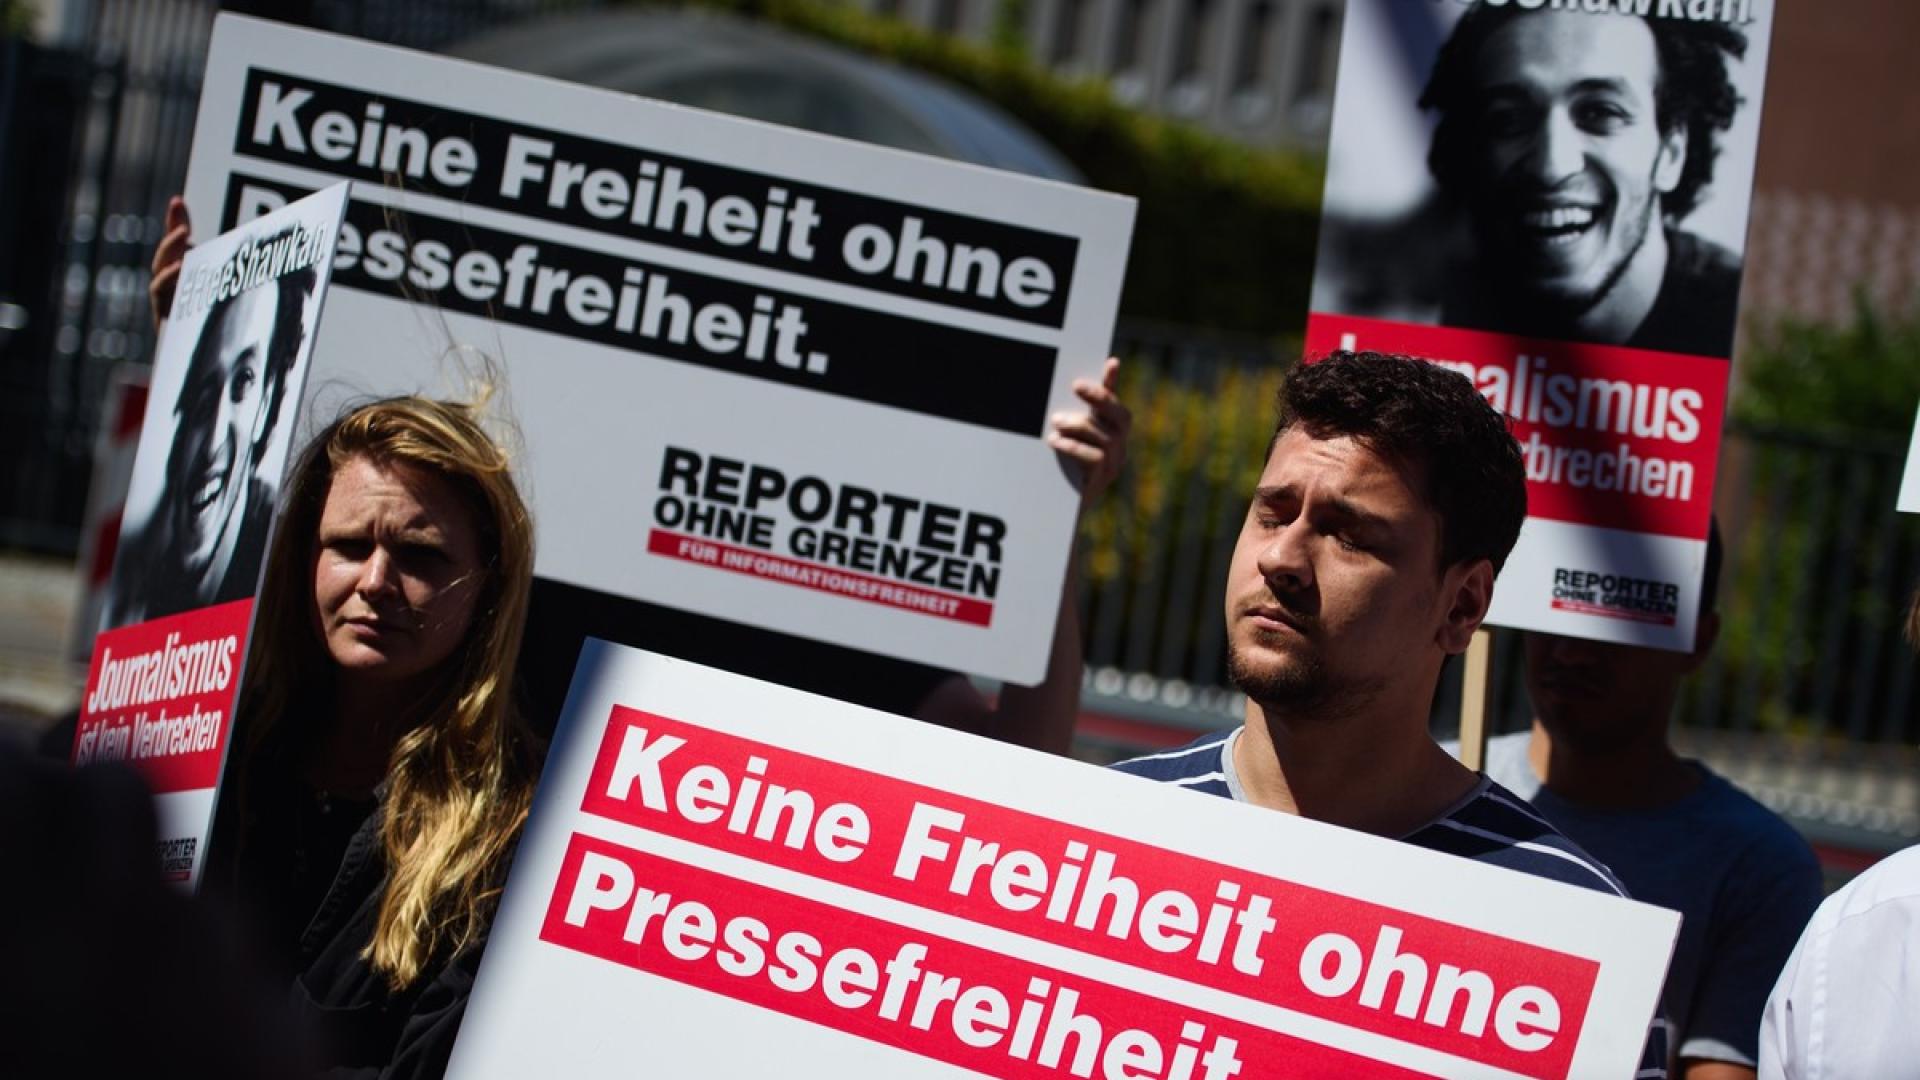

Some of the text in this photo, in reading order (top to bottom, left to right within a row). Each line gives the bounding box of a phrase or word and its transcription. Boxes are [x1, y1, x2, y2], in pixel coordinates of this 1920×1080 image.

[252, 80, 1056, 308] Keine Freiheit ohne
[236, 185, 829, 374] Pessefreiheit.
[654, 496, 1001, 598] OHNE GRENZEN
[658, 445, 1008, 562] REPORTER
[678, 539, 960, 616] FÜR INFORMATIONSFREIHEIT
[1554, 568, 1679, 601] REPORTER
[87, 631, 236, 714] Journalismus
[131, 703, 222, 759] Verbrechen
[605, 725, 1562, 1053] Keine Freiheit ohne
